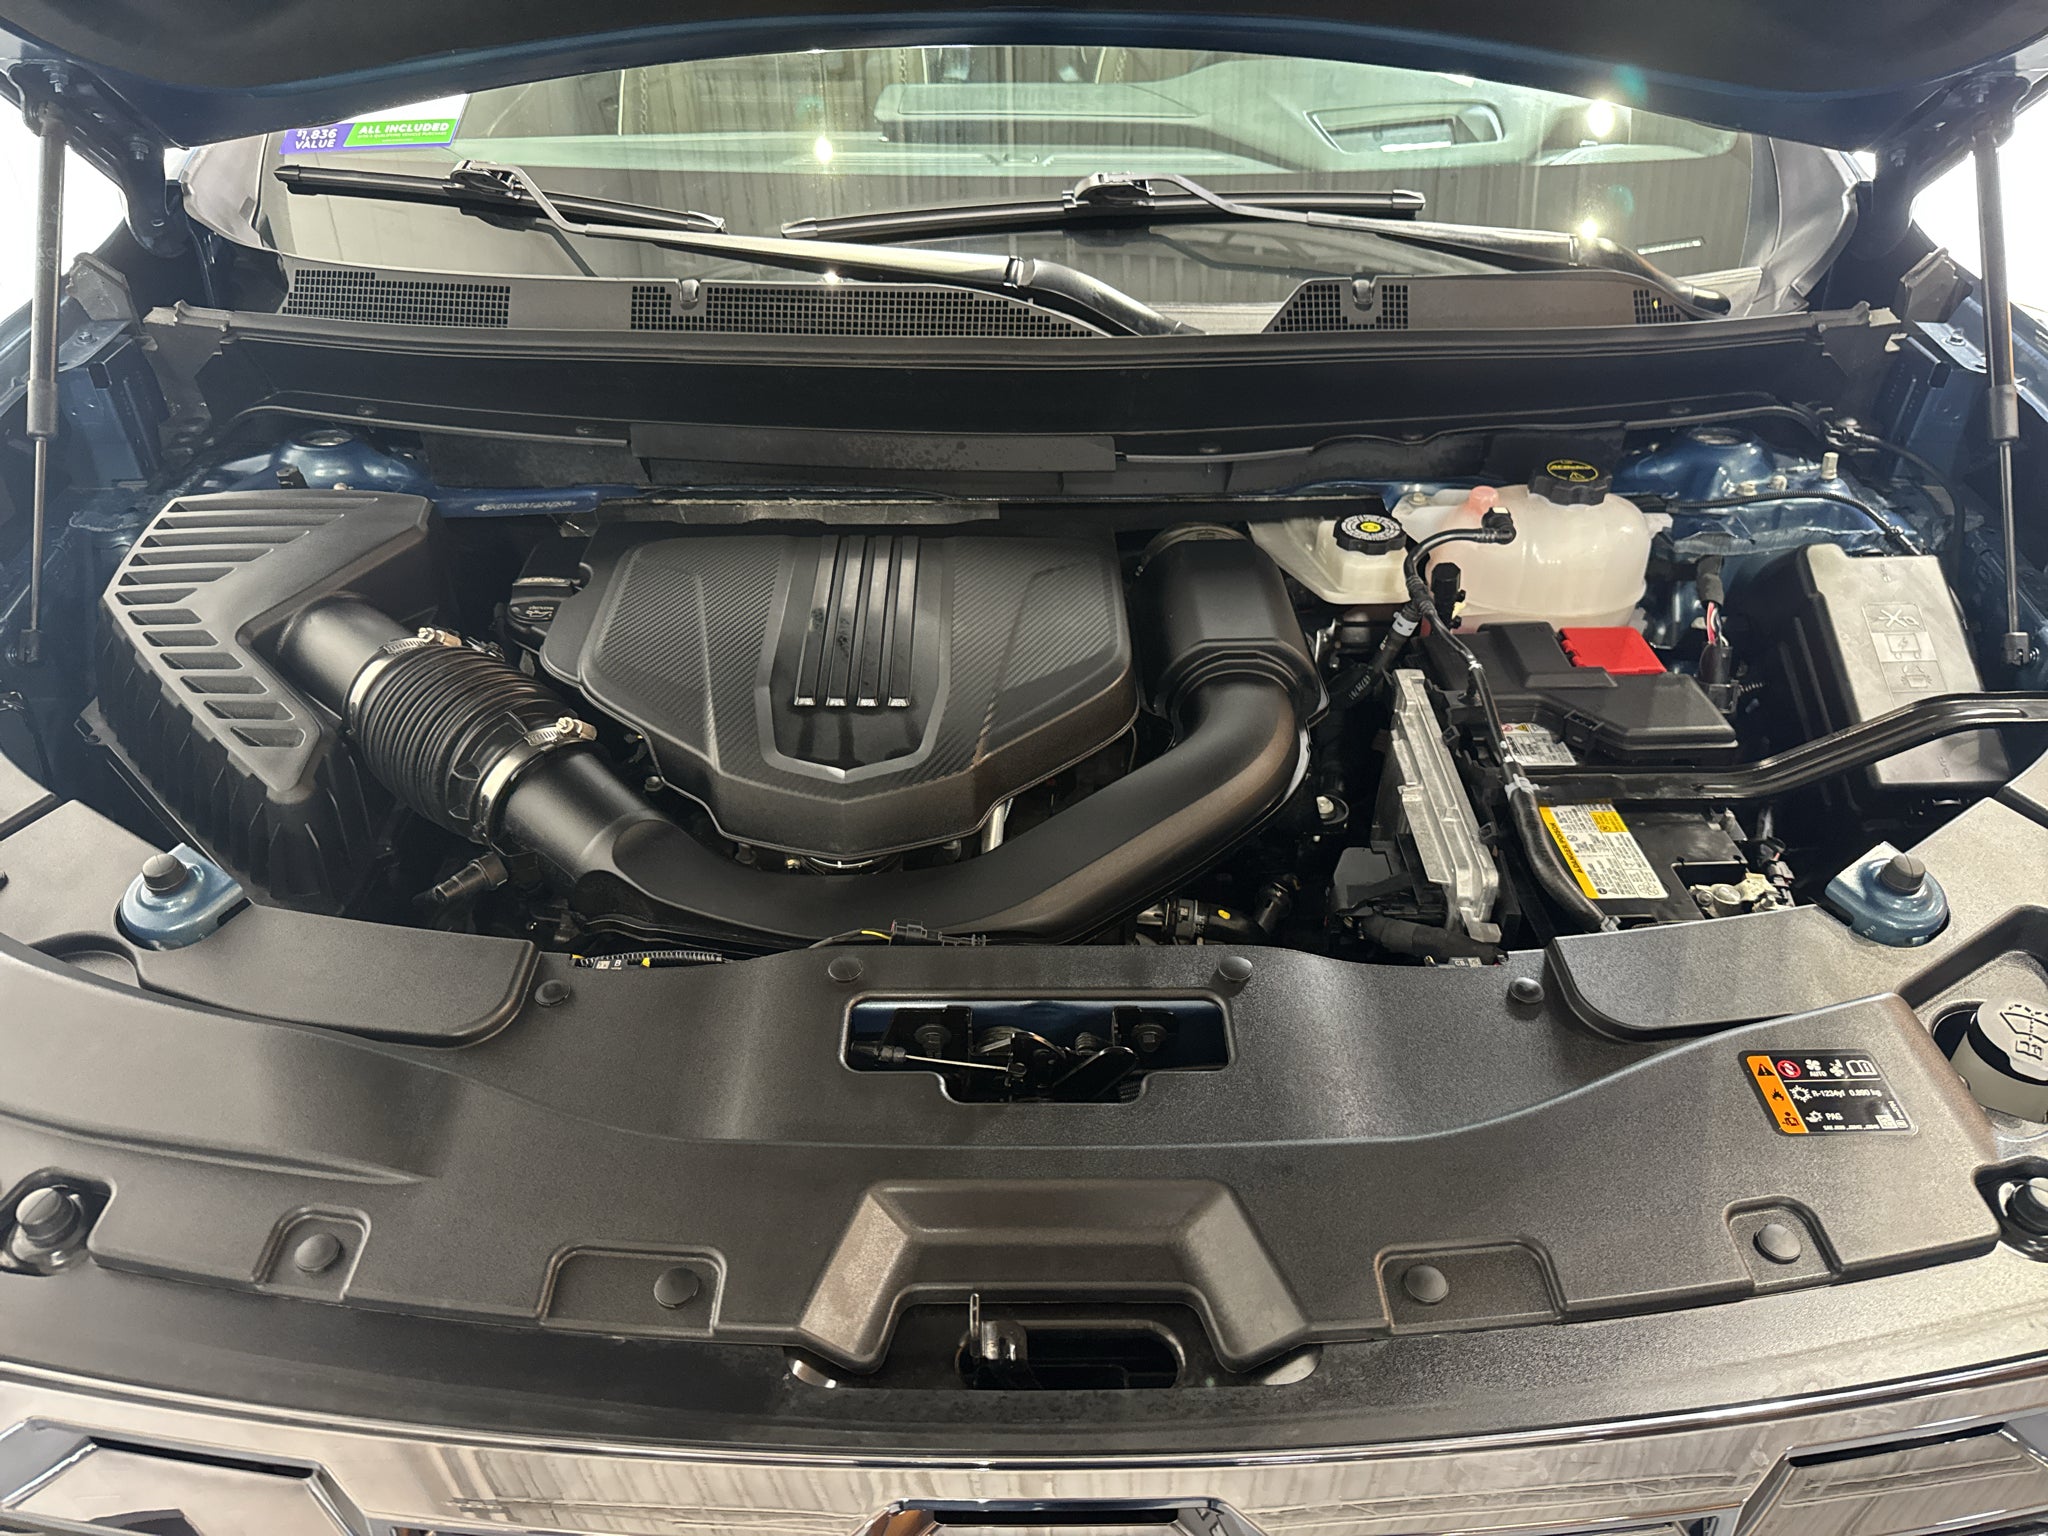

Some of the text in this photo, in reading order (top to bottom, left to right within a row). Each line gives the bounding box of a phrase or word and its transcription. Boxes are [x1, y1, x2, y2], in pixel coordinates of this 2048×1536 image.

[359, 122, 449, 134] ALL INCLUDED
[296, 128, 338, 141] $1,836
[295, 139, 336, 150] VALUE
[1825, 1112, 1844, 1120] PAG
